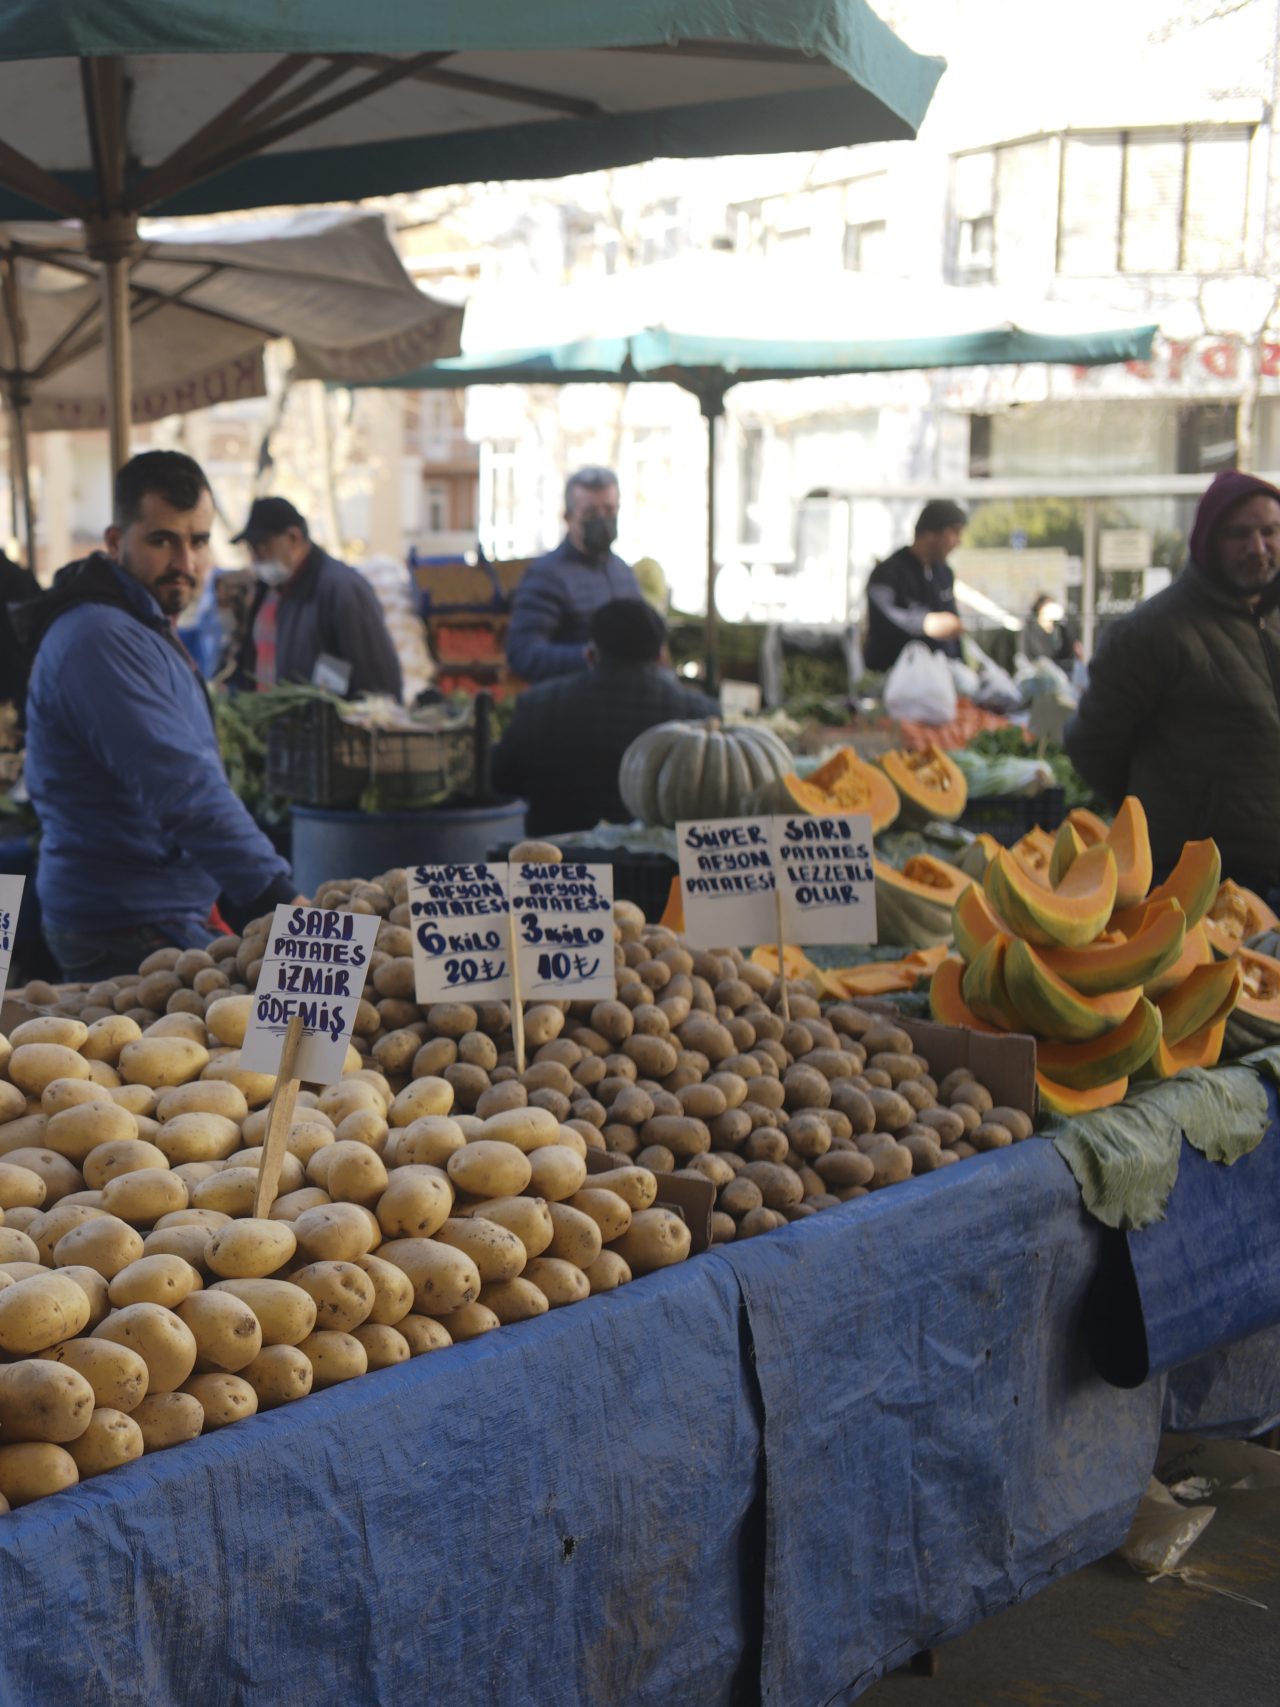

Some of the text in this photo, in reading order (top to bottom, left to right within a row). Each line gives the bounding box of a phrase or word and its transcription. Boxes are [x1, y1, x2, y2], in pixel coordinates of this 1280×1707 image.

[685, 825, 767, 848] SÜPER
[785, 819, 851, 841] SARI
[697, 851, 772, 871] AFYON
[780, 844, 869, 860] PATATES
[413, 863, 495, 884] SÜPER
[520, 863, 596, 881] SÜPER
[429, 882, 504, 899] AFYON
[529, 883, 597, 897] AFYON
[795, 885, 859, 904] OLUR
[288, 908, 353, 941] SARI
[521, 913, 543, 943] 3
[416, 921, 446, 955] 6
[274, 938, 366, 966] PATATES
[278, 963, 350, 997] İZMİR
[257, 994, 346, 1042] ÖDEMİŞ
